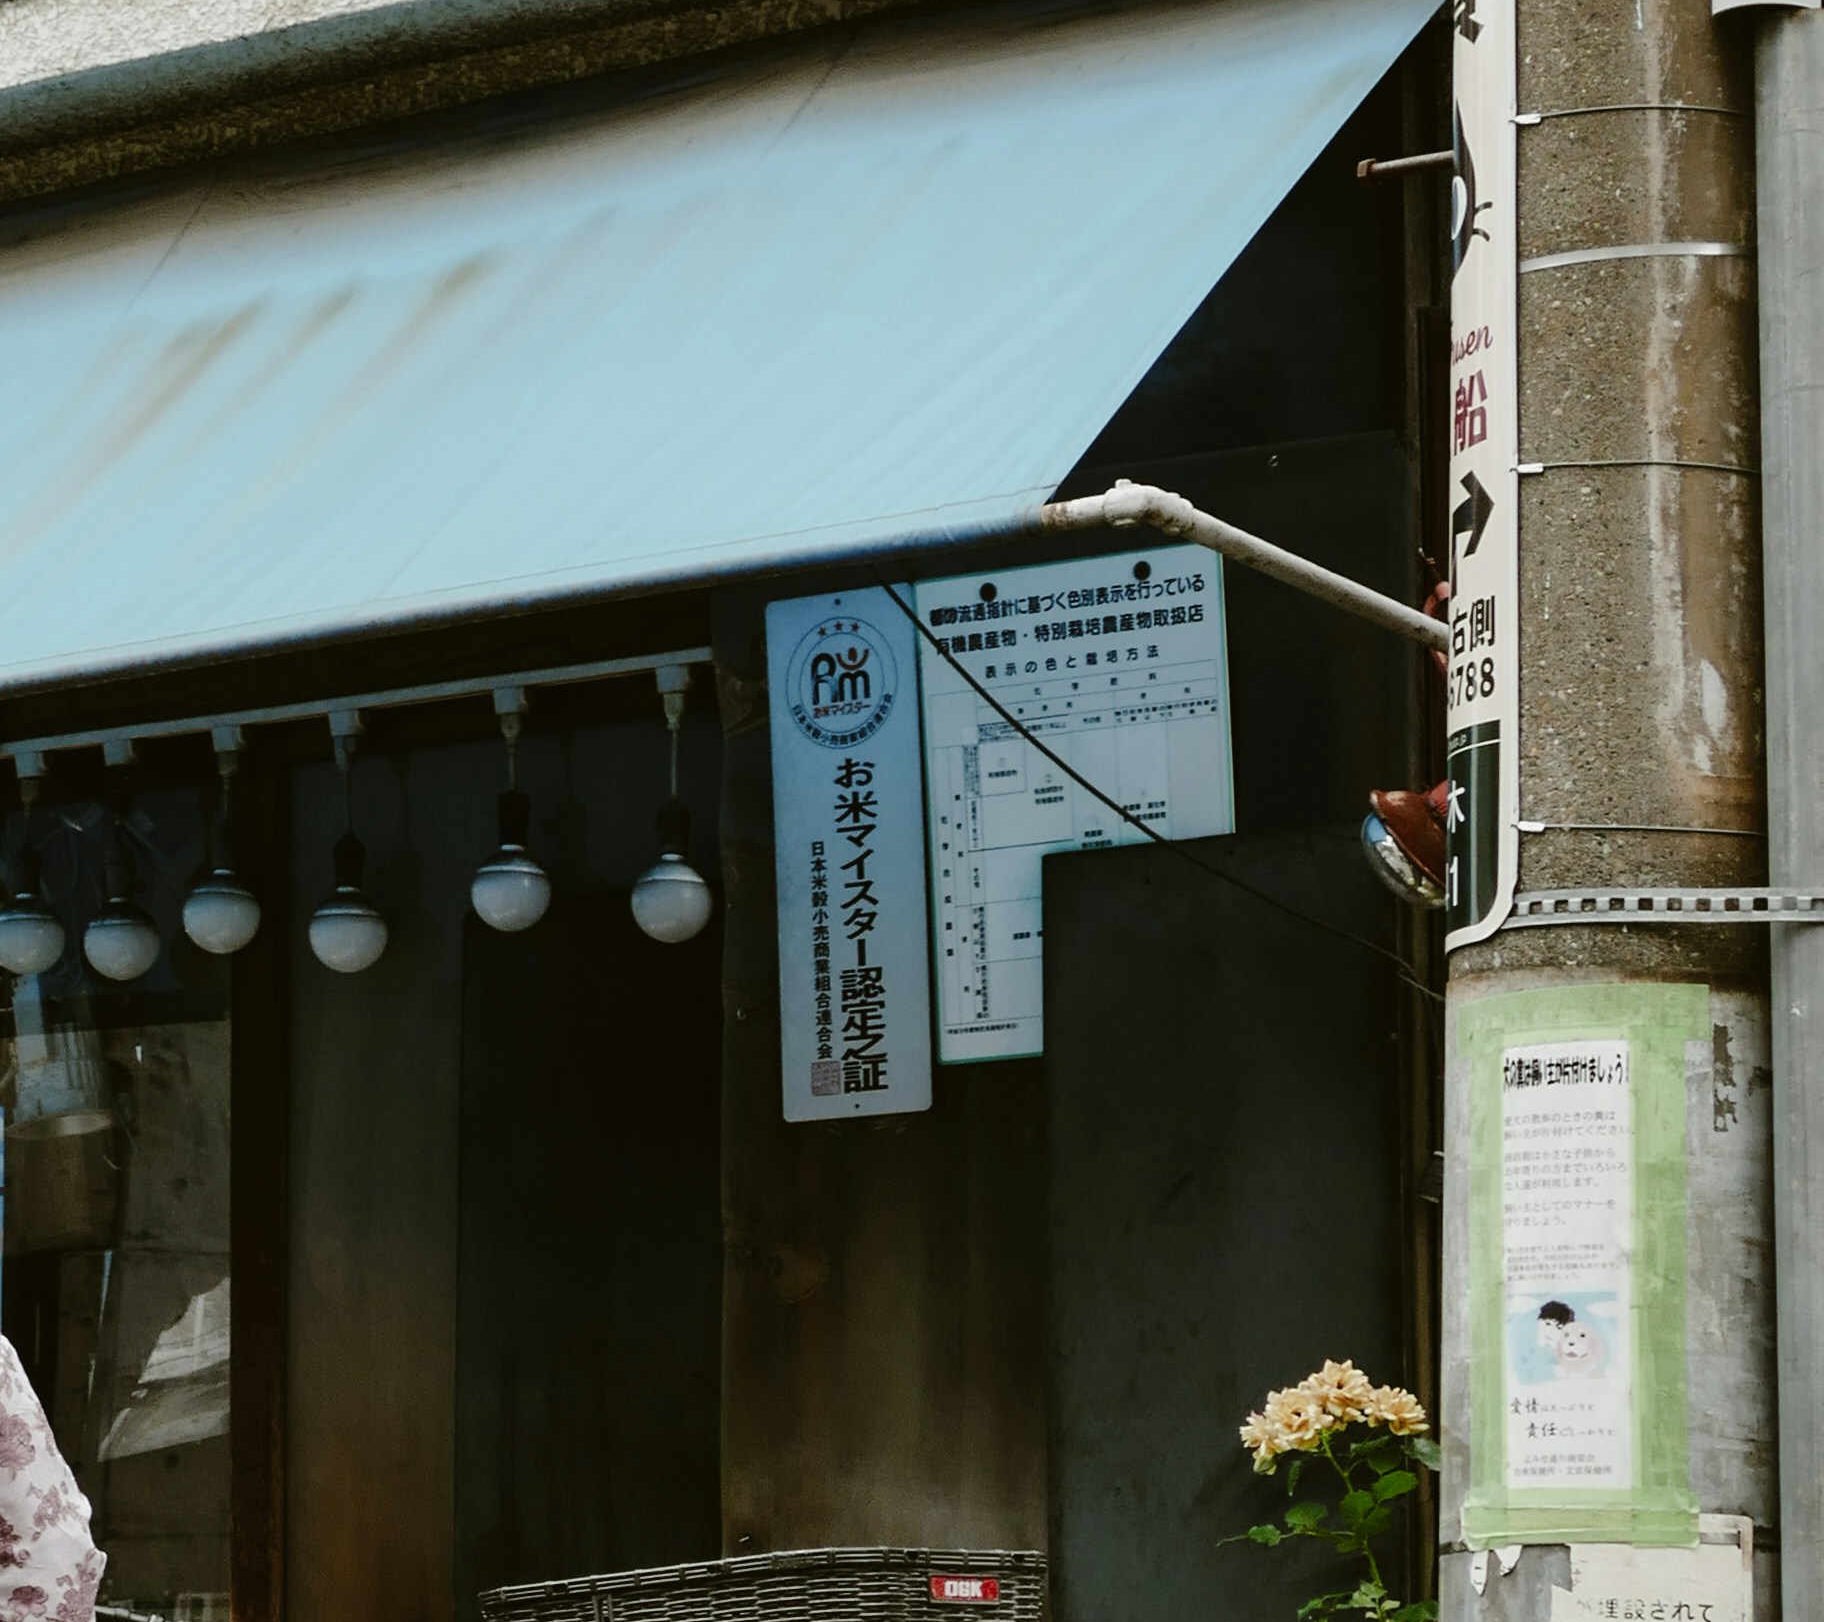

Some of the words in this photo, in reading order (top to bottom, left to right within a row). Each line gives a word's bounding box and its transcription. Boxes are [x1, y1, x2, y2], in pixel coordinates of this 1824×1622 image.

[811, 840, 834, 1061] 日本米穀小売商業組合連合会
[833, 758, 889, 1094] お米マイスター認定之証
